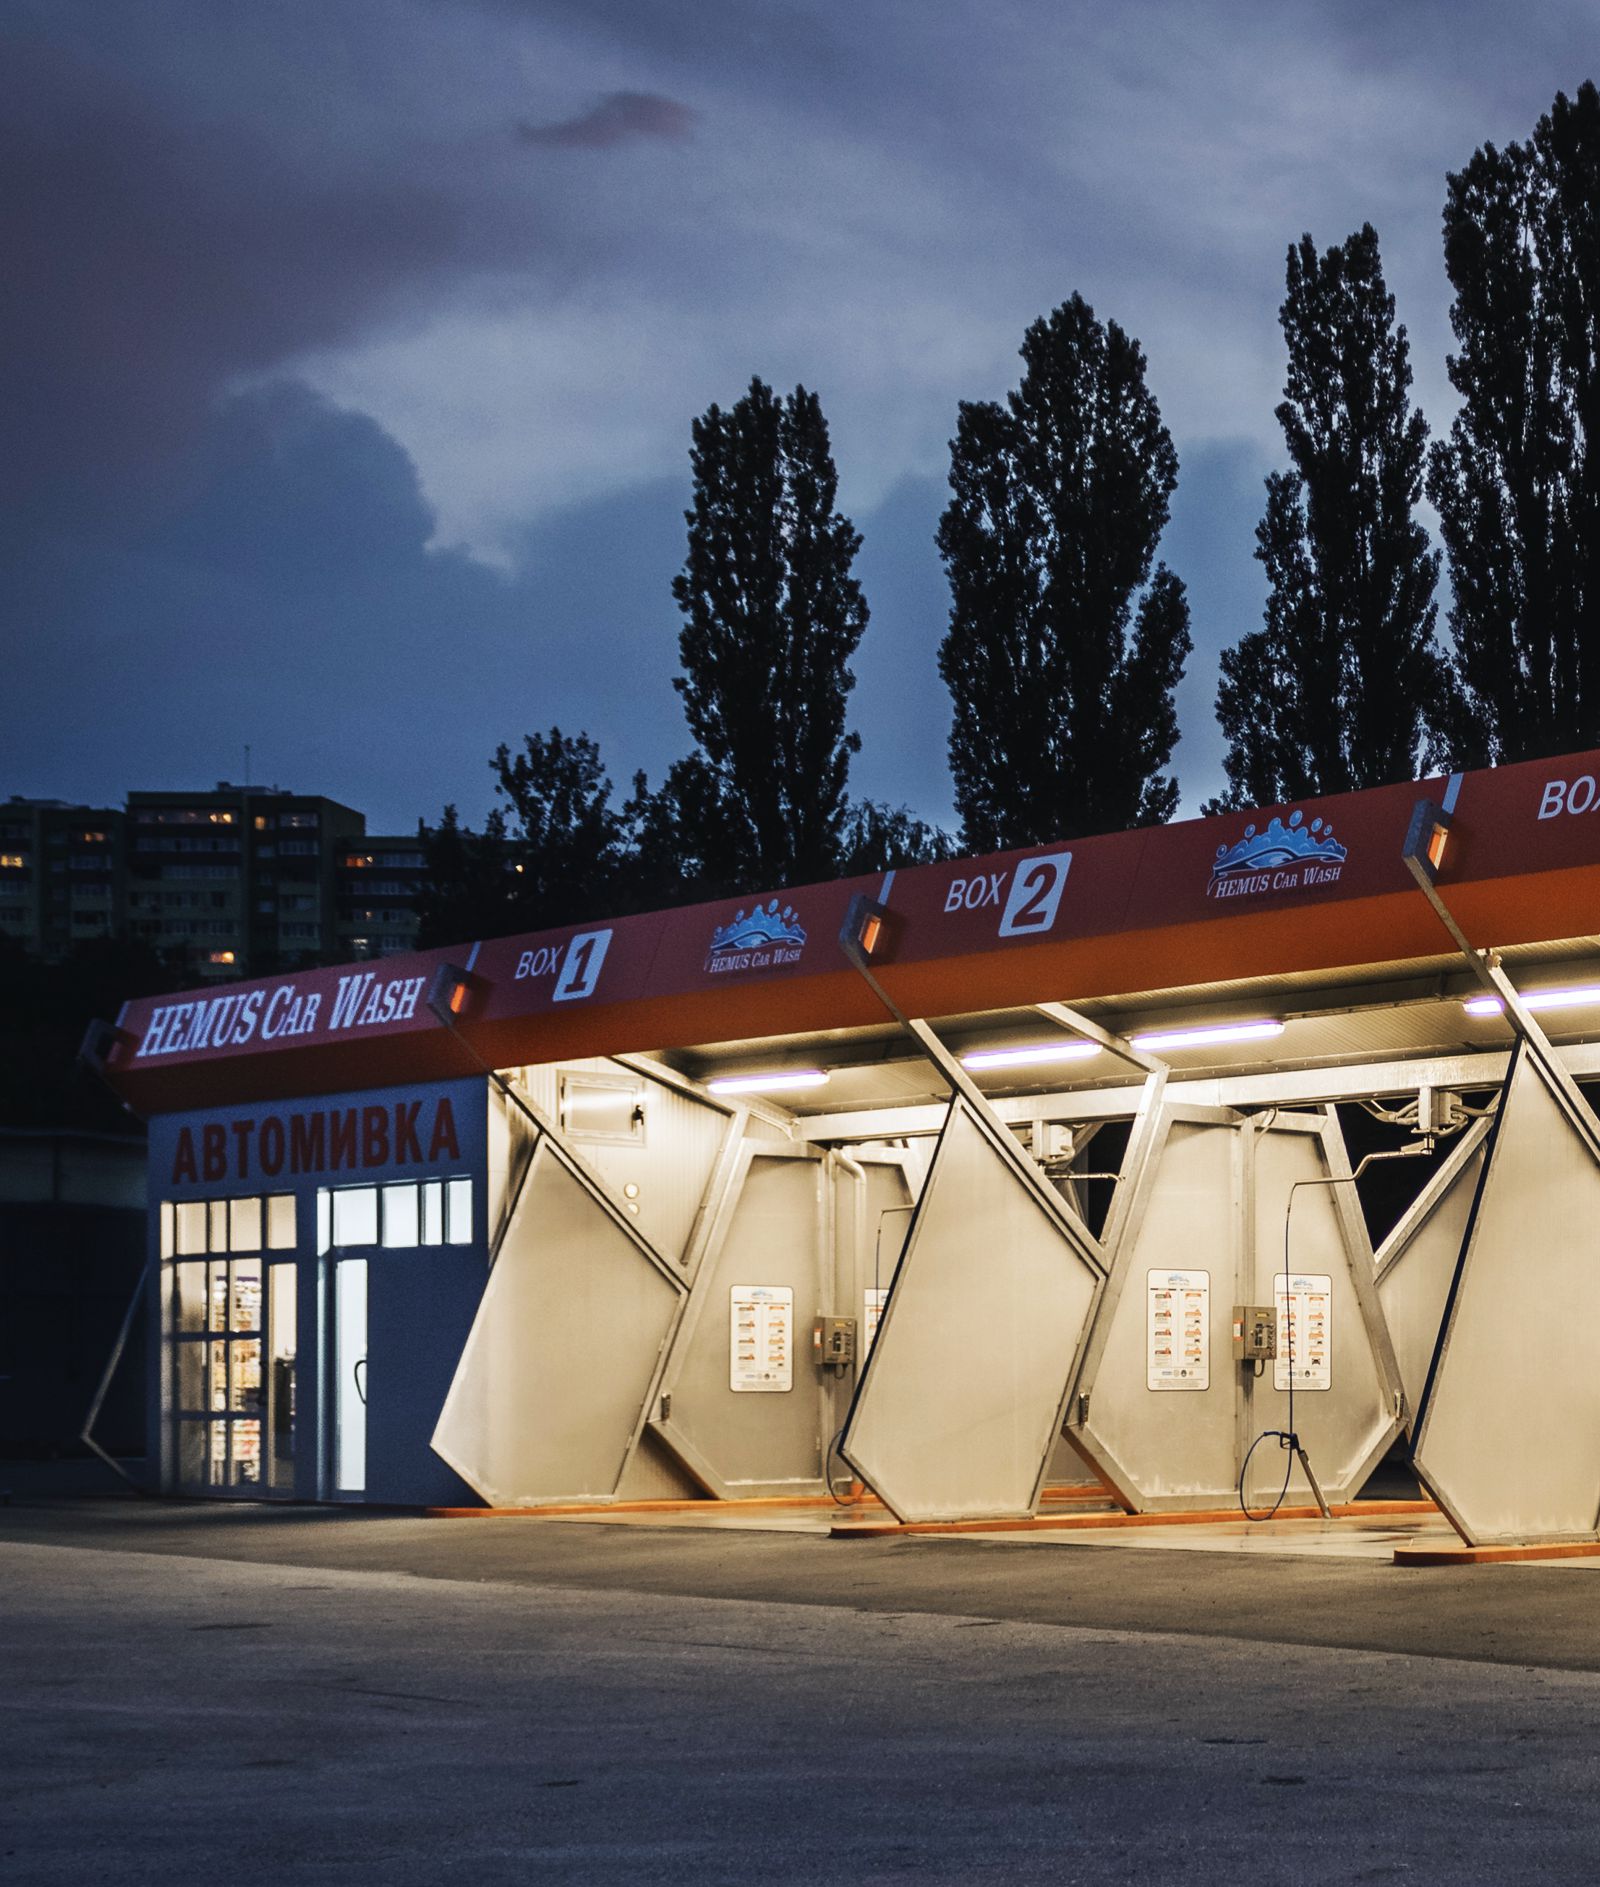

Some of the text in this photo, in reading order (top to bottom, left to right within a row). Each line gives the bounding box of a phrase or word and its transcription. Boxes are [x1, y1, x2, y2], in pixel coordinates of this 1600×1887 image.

[944, 863, 1057, 928] BOX 2
[1214, 874, 1269, 898] HEMUS
[514, 934, 597, 995] BOX 1
[709, 953, 751, 973] HEMUS
[136, 989, 269, 1058] HEMUS
[171, 1097, 460, 1185] АВТОМИВКА
